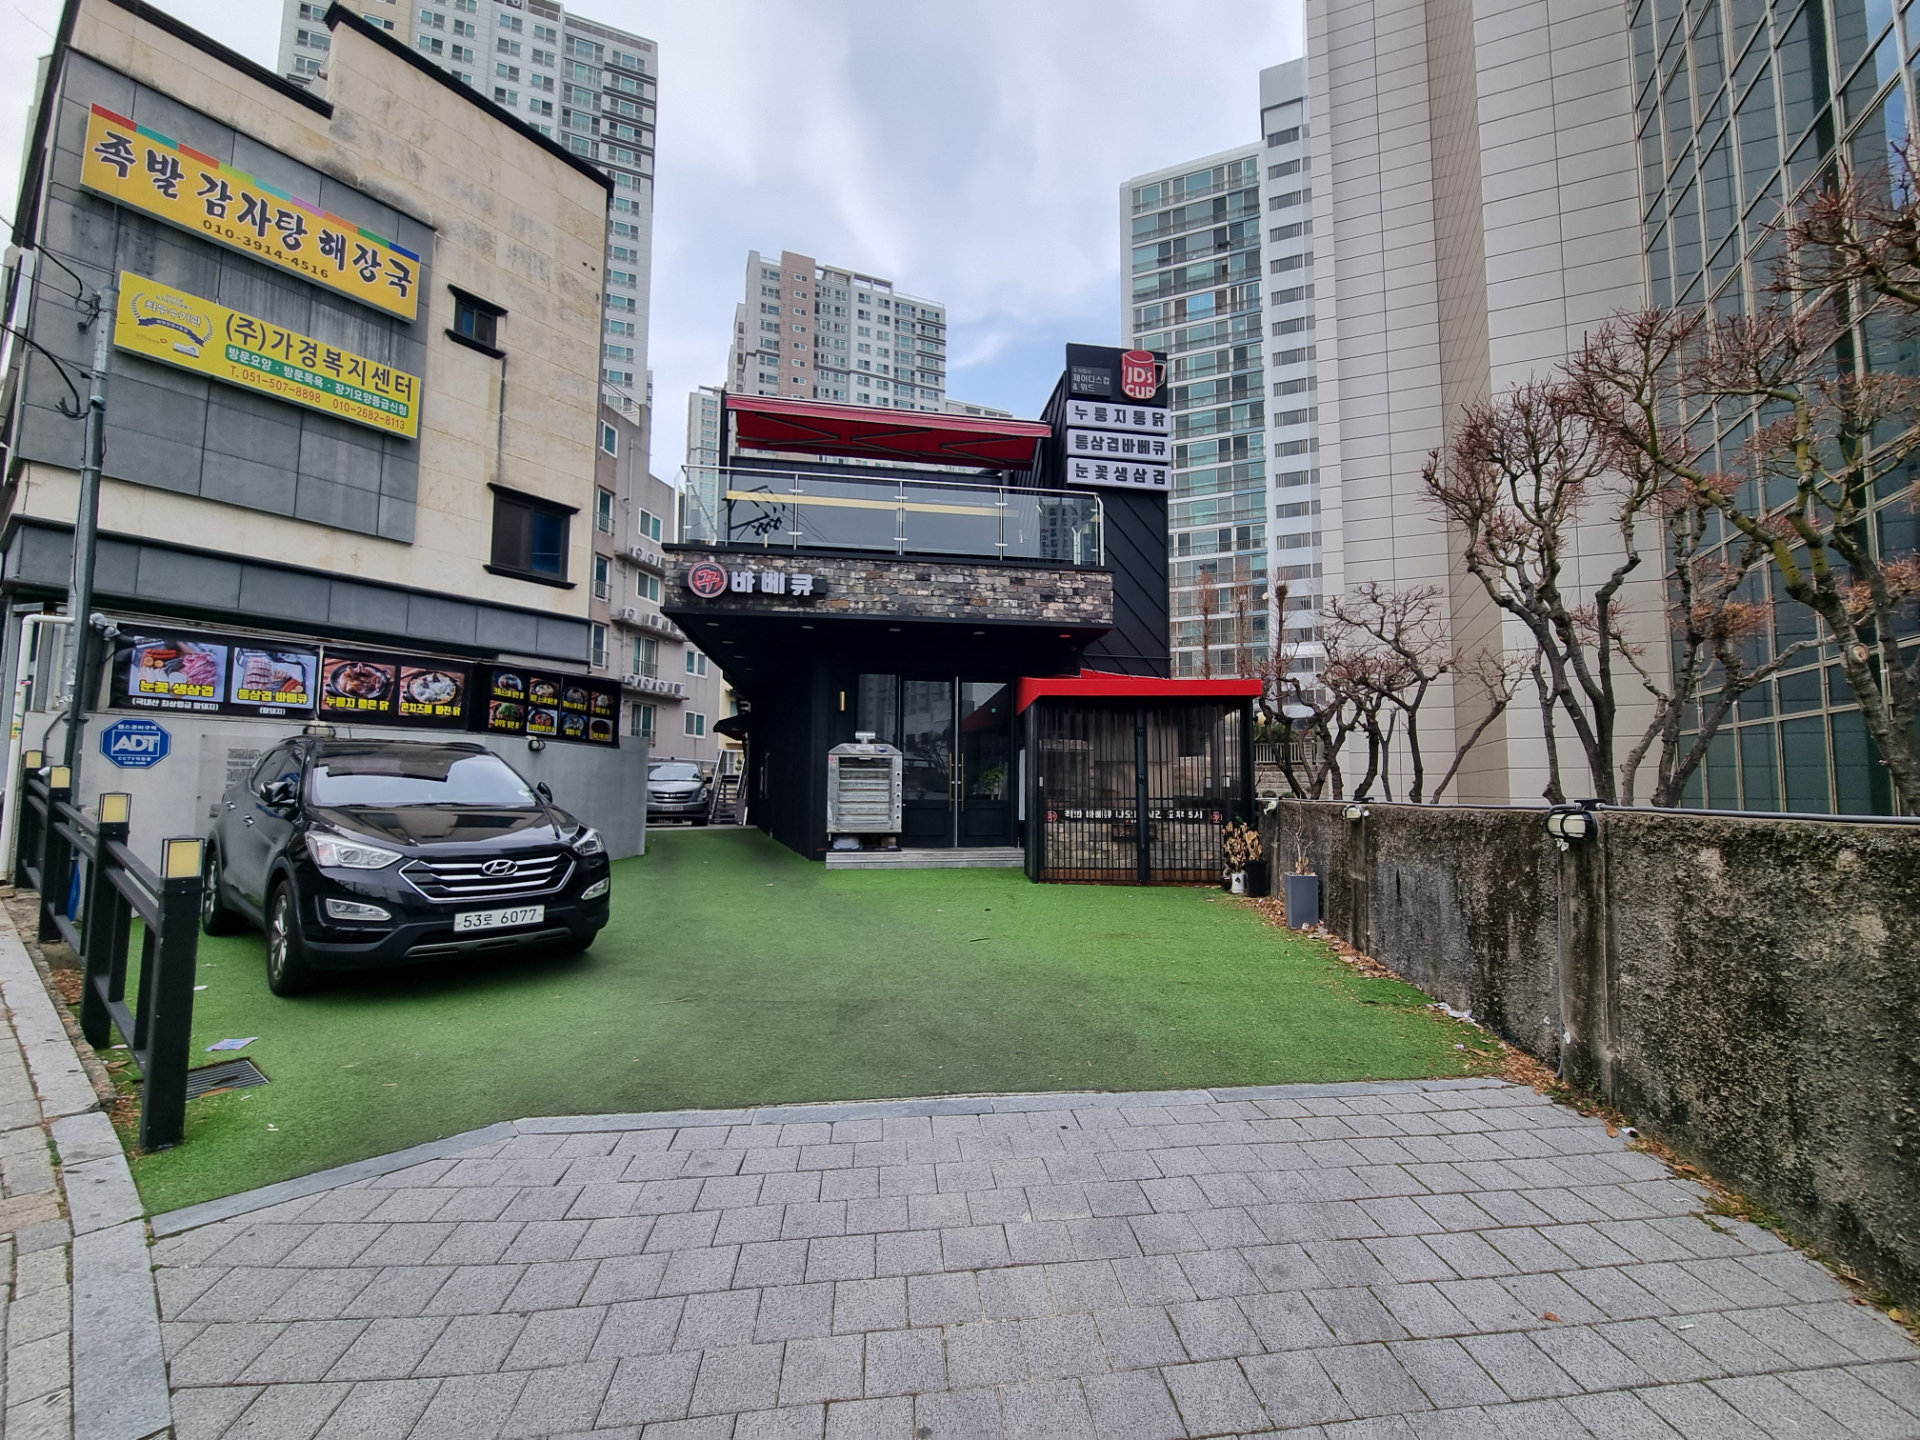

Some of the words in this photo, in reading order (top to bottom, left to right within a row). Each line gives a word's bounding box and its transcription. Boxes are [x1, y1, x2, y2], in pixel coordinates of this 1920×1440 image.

[93, 130, 185, 199] 족발
[196, 172, 309, 251] 감자탕
[318, 229, 414, 298] 해장국
[203, 220, 330, 279] 010-3914-4516
[145, 300, 202, 328] 최우수기관
[226, 313, 413, 402] (주)가경복지센터
[228, 346, 272, 371] 방문요양
[283, 365, 324, 389] 방문목욕
[334, 383, 408, 416] 장기요양등급신청
[1072, 373, 1110, 385] 제이디스컵
[1125, 384, 1156, 399] CUP
[332, 398, 406, 430] 010-2682-8113
[1074, 405, 1166, 428] 누룽지통닭
[1074, 434, 1166, 456] 통삼겹바베큐
[1074, 463, 1166, 486] 눈꽃생삼겹
[140, 680, 170, 694] 눈꽃
[172, 682, 215, 697] 생삼겹
[275, 691, 308, 704] 바베큐
[325, 696, 356, 708] 누룽지
[113, 734, 159, 752] ADT
[1187, 810, 1203, 820] 5시
[463, 913, 493, 928] 53로
[500, 908, 537, 924] 6077
